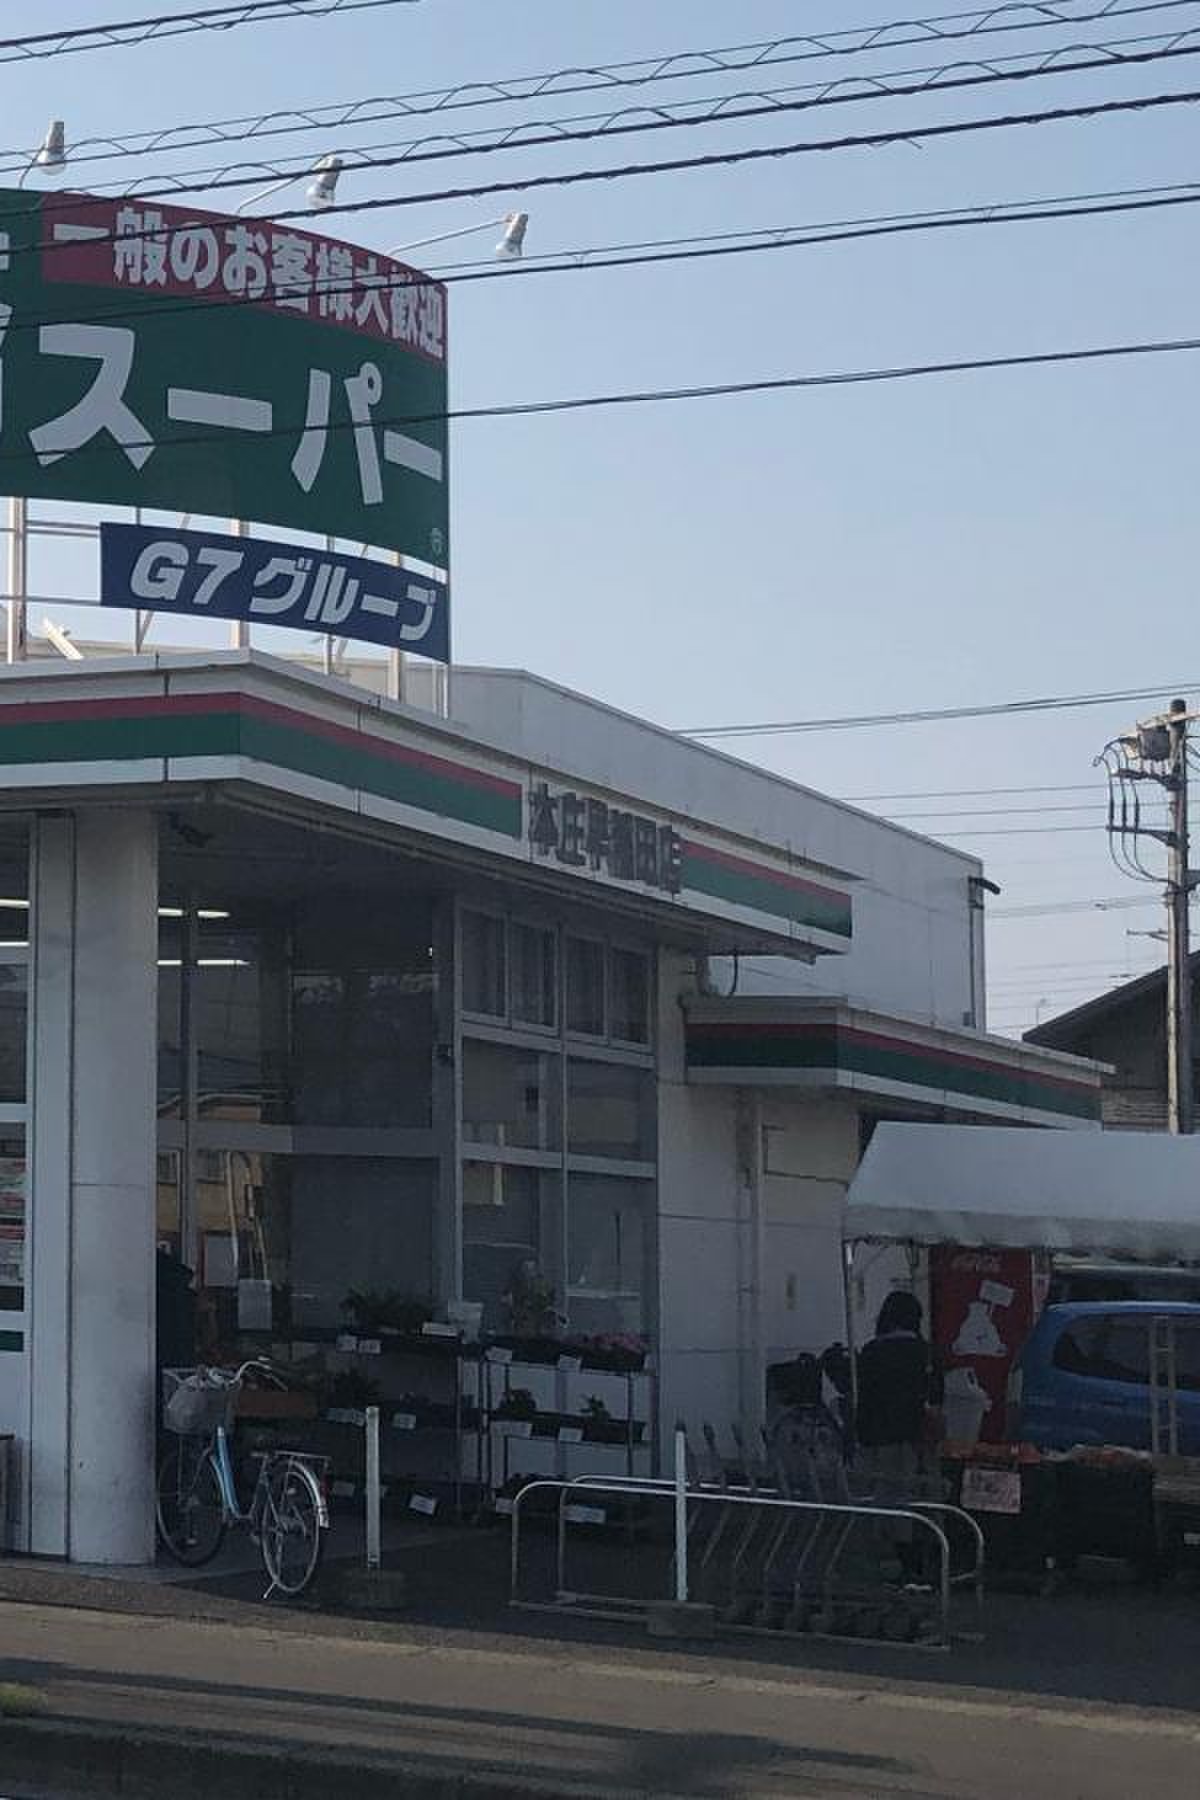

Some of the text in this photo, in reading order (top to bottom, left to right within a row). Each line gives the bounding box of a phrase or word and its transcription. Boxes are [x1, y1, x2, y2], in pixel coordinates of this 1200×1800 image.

[53, 207, 443, 358] 一般のお客様大歓迎
[130, 541, 436, 642] G7 グループ
